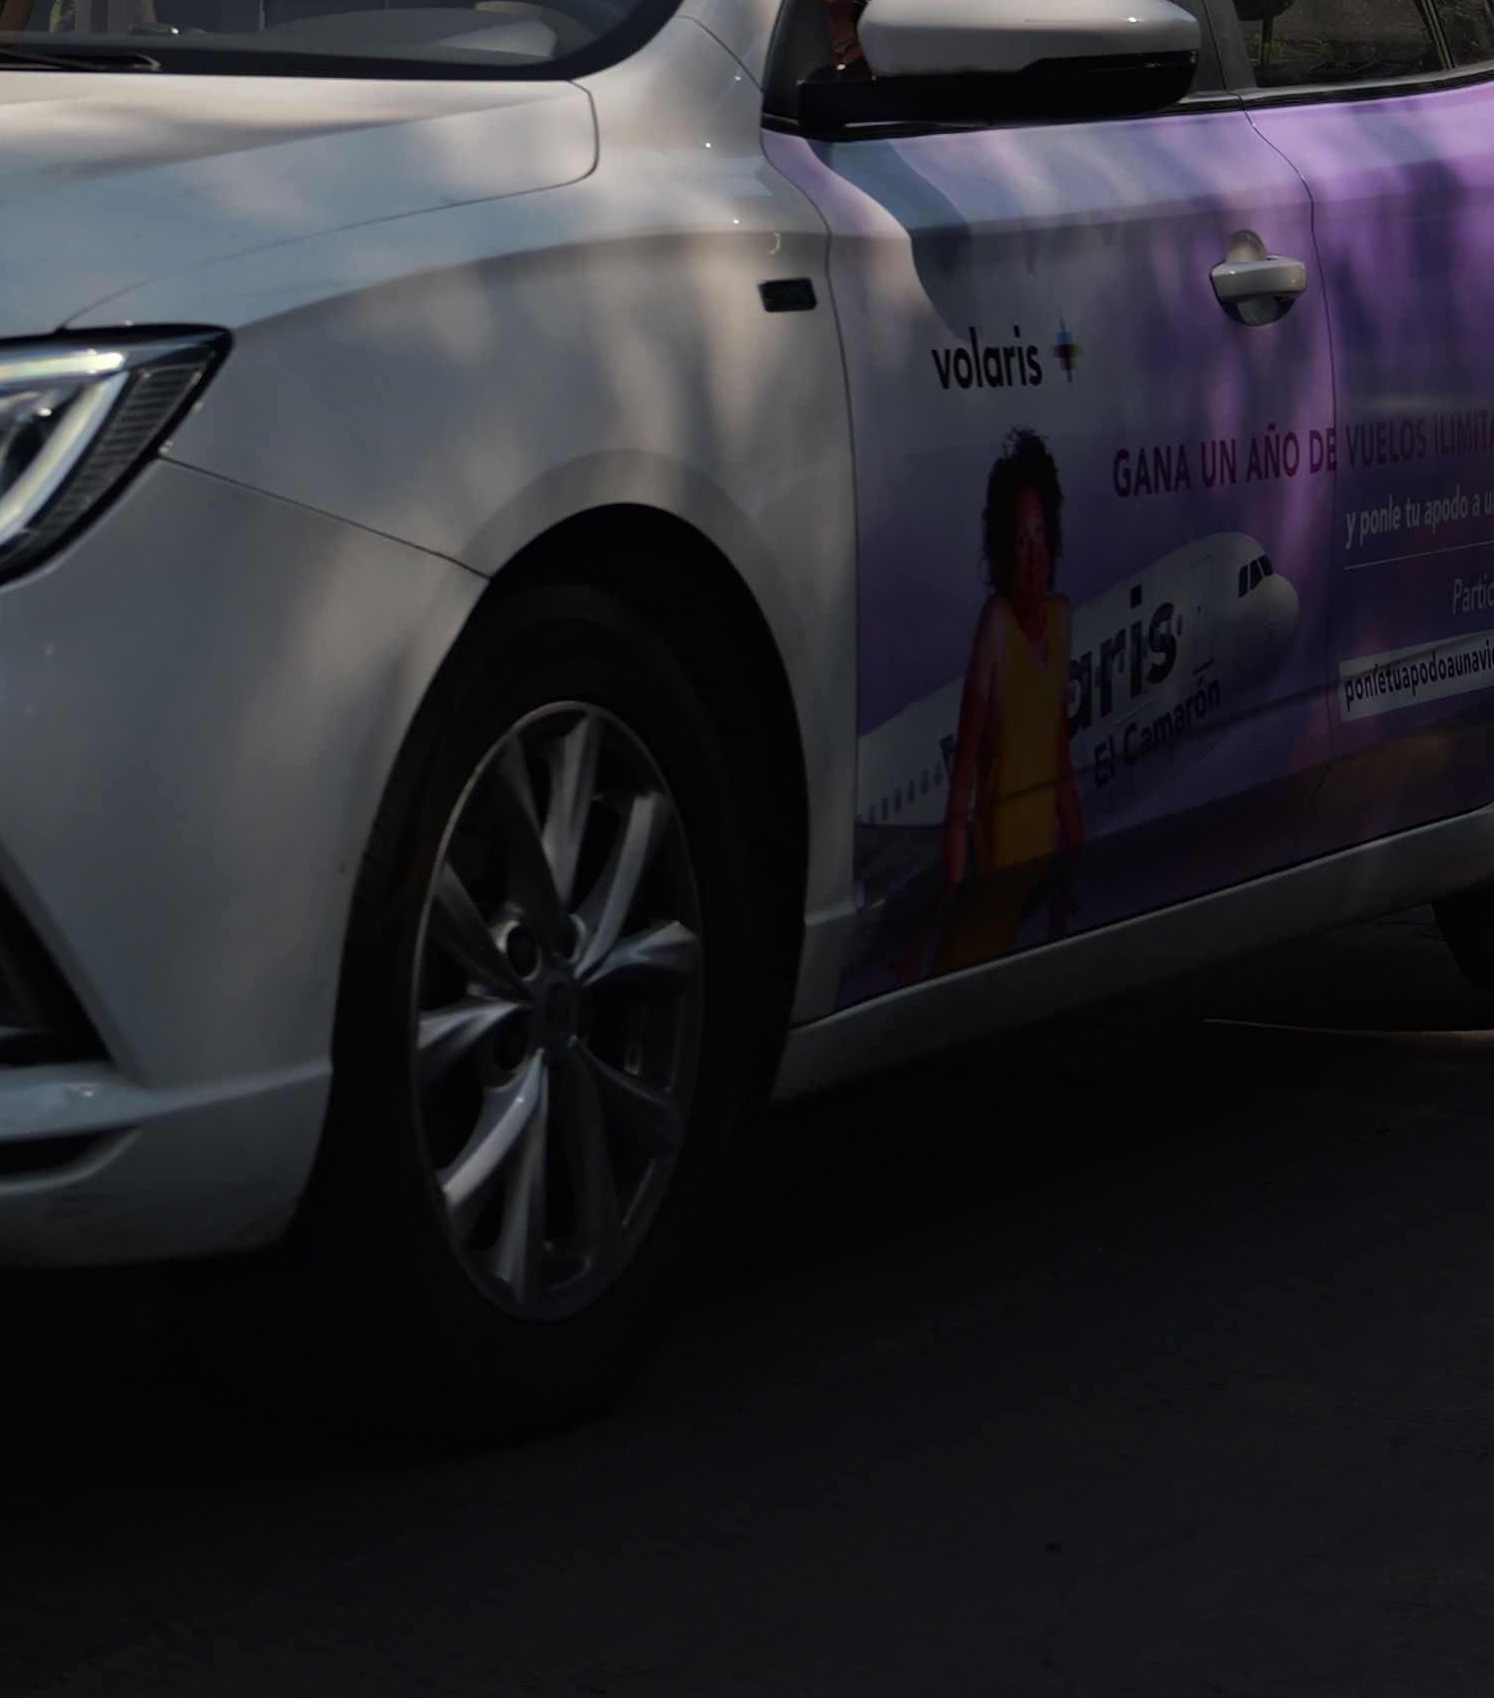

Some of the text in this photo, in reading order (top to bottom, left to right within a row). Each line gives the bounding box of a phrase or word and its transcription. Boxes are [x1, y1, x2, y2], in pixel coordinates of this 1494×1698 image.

[931, 325, 1042, 390] volaris
[1113, 445, 1192, 498] GANA
[1201, 439, 1237, 488] UN
[1245, 423, 1299, 482] AÑO
[1309, 428, 1338, 474] DE
[1345, 416, 1425, 469] VUELOS
[1345, 512, 1356, 550] y
[1359, 494, 1402, 547] ponle
[1405, 497, 1421, 528] tu
[1424, 483, 1469, 534] apodo
[1472, 492, 1481, 517] a
[1094, 676, 1221, 789] El Camarón
